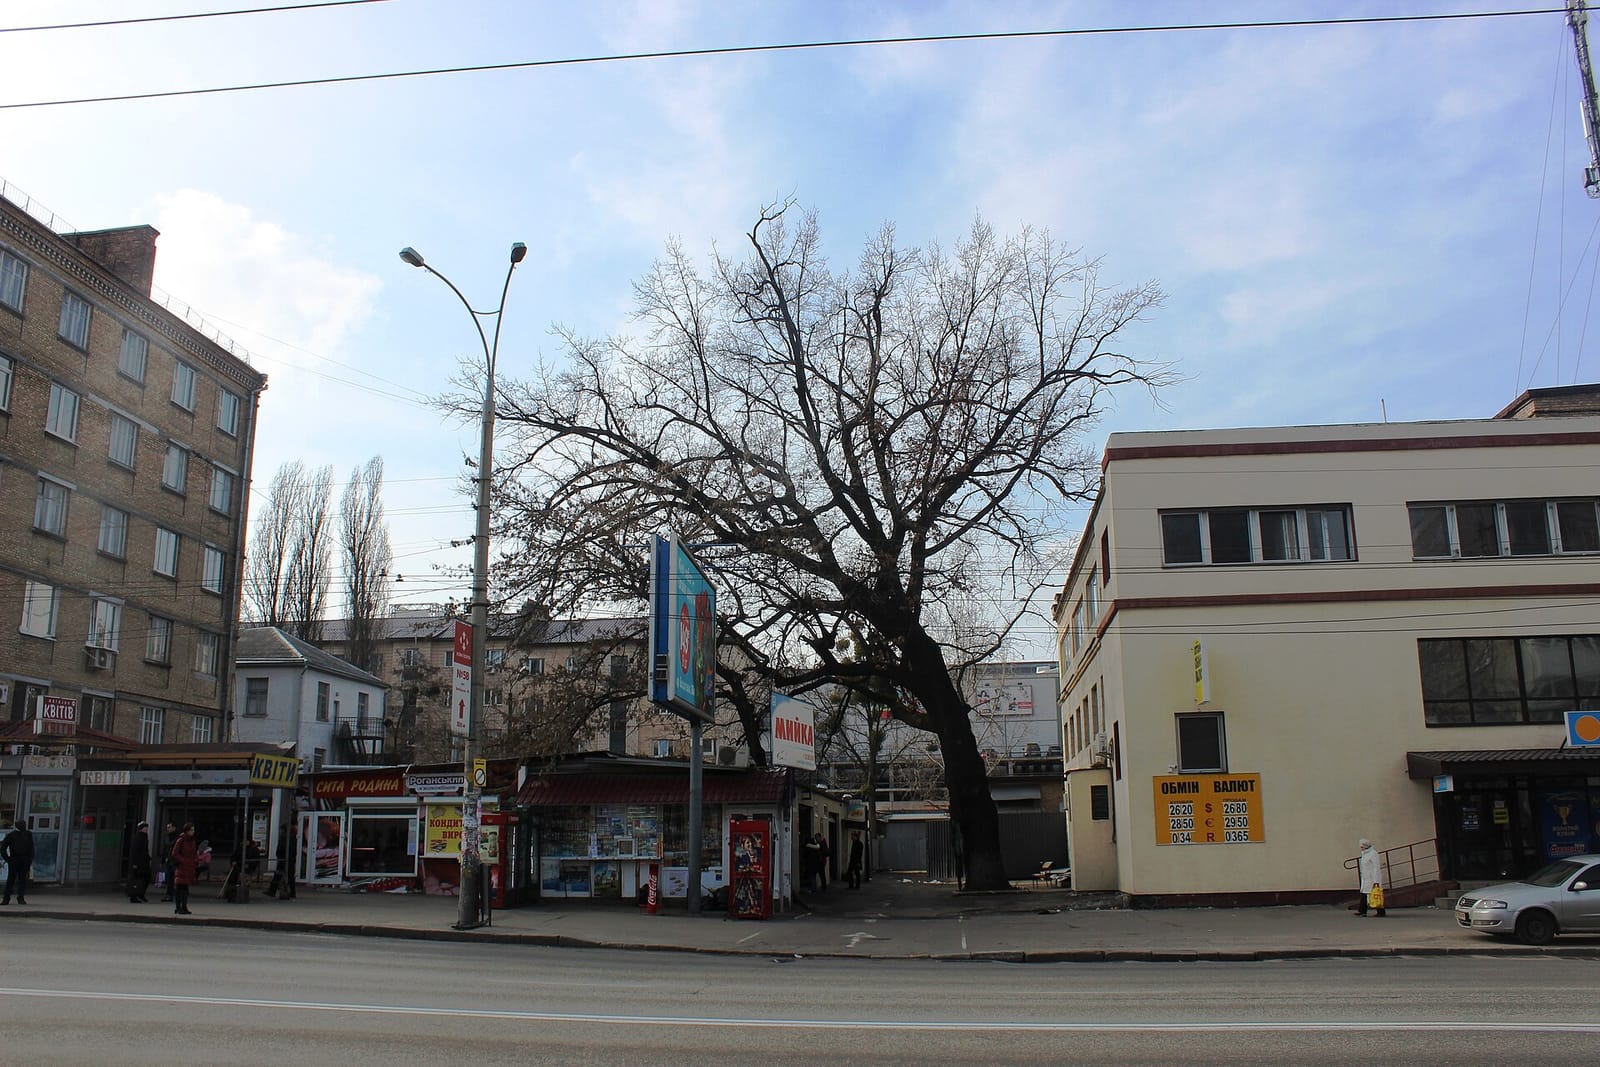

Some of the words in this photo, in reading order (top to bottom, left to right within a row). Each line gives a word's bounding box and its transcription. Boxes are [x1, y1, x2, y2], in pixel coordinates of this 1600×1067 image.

[43, 703, 74, 720] КВІТІВ
[775, 716, 814, 746] МИЙКА
[252, 757, 296, 782] КВІТИ
[84, 771, 129, 784] КВІТИ
[316, 780, 344, 793] СИТА
[350, 778, 399, 791] РОДИНА
[1162, 782, 1199, 794] ОБМІН
[1214, 780, 1255, 792] ВАЛЮТ
[1207, 832, 1215, 842] R
